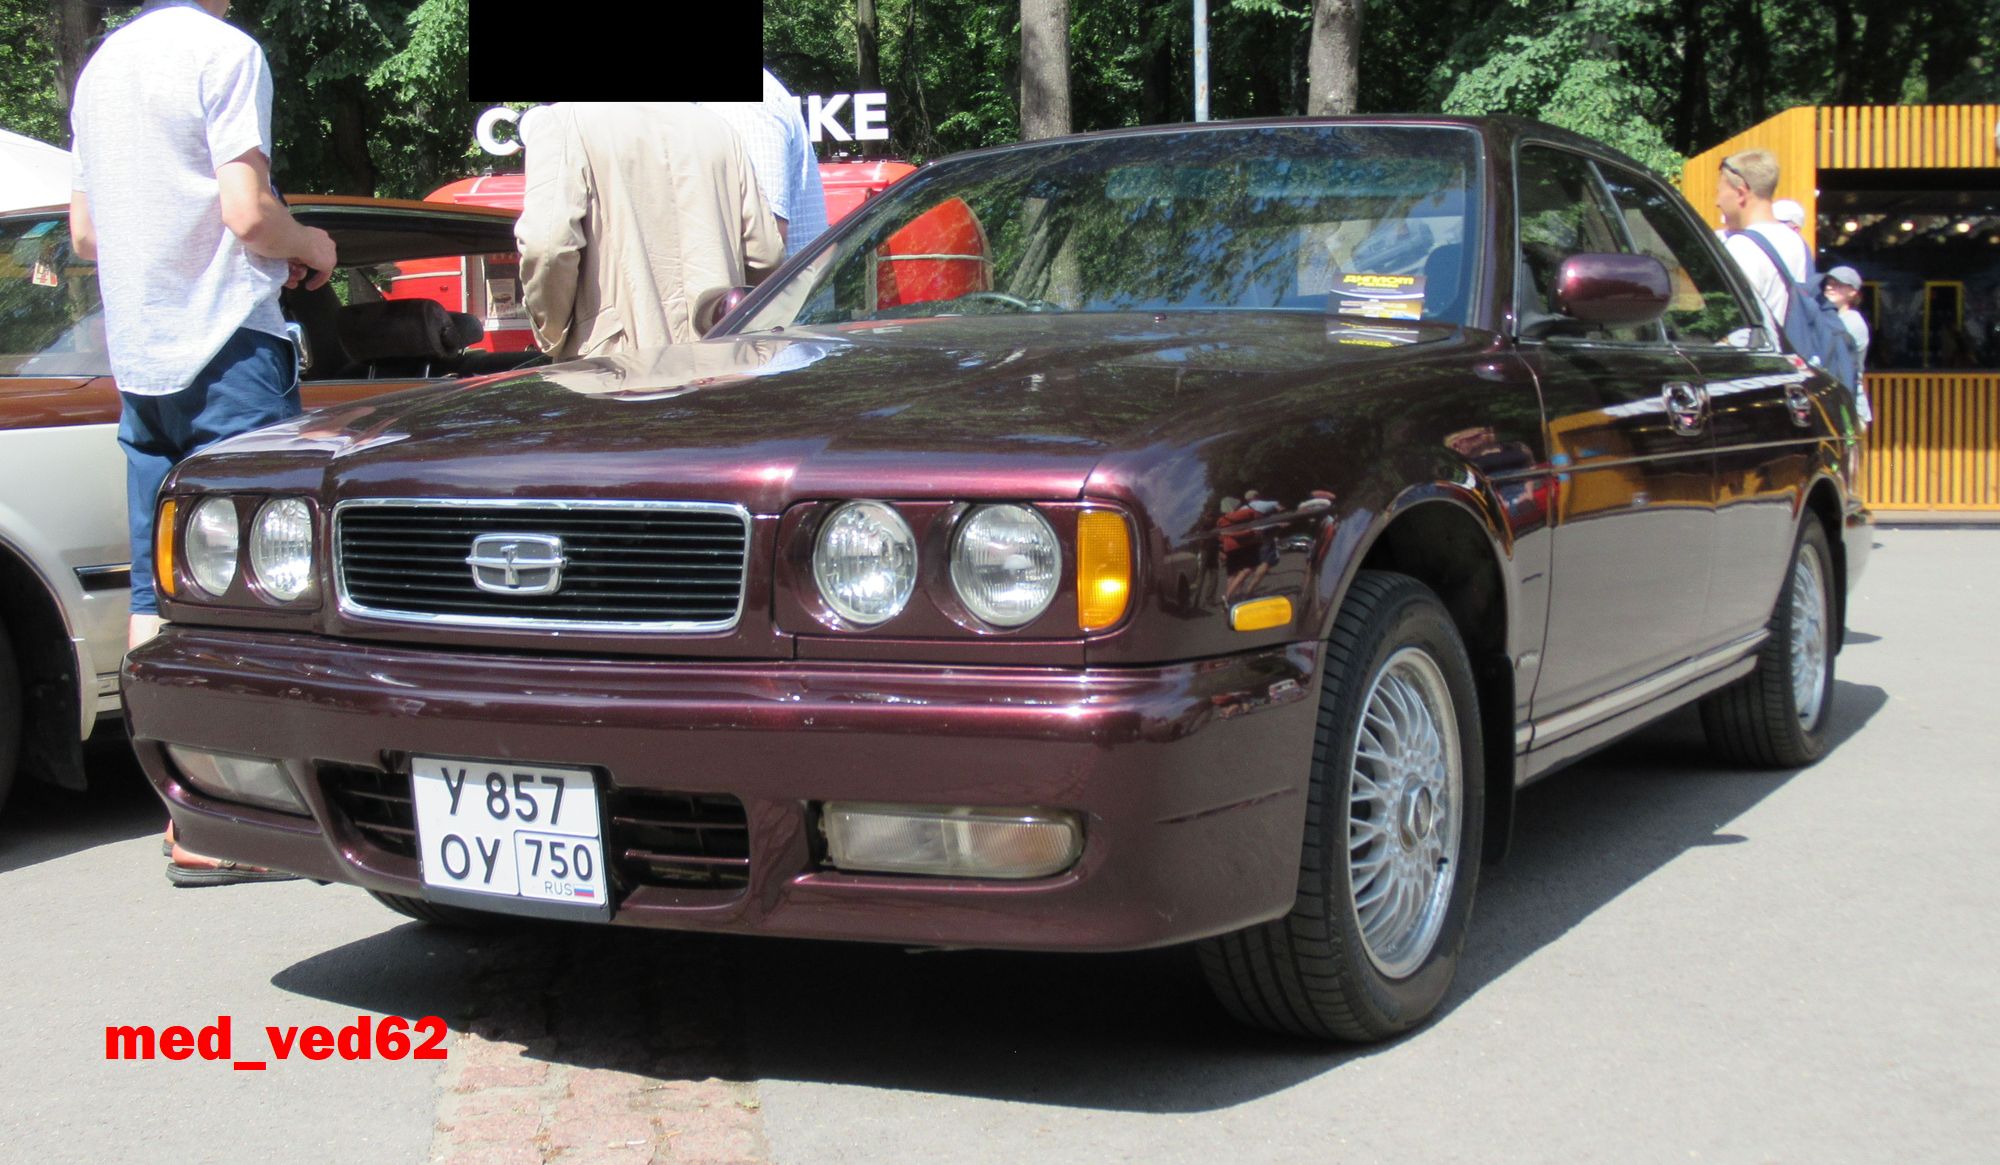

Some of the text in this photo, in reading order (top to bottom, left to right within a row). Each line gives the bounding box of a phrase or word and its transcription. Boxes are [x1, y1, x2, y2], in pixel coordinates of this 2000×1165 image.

[485, 772, 566, 826] 857
[524, 838, 593, 881] 750
[544, 880, 573, 897] RUS
